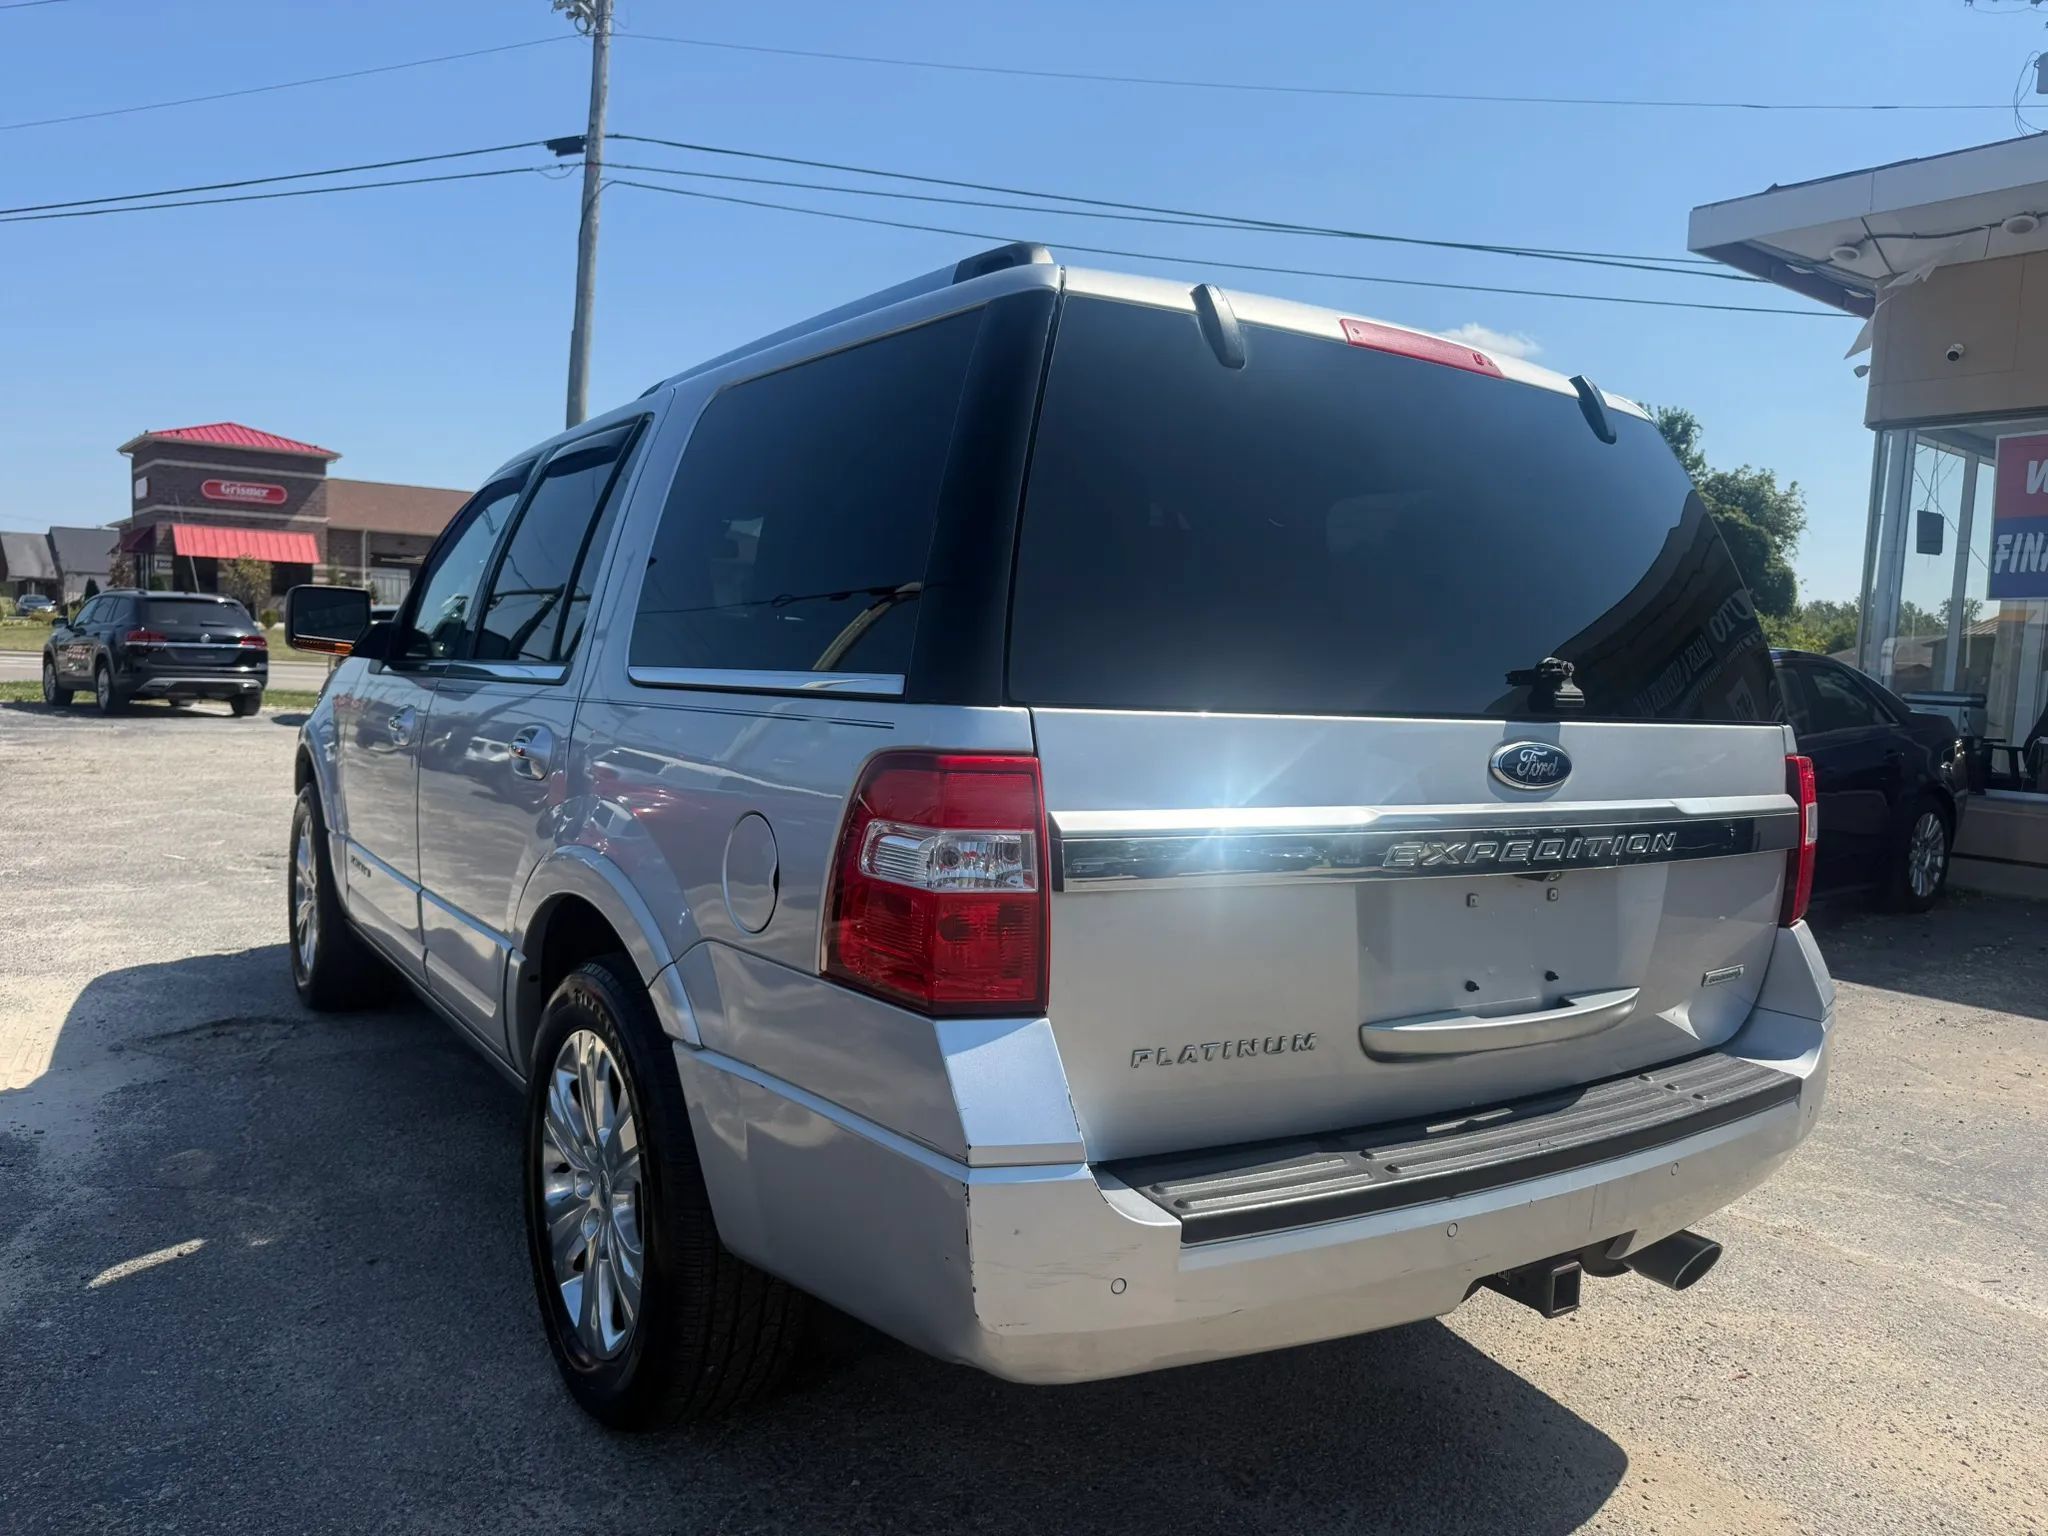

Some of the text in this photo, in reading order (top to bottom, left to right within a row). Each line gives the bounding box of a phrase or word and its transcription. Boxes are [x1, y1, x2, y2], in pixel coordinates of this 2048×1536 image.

[1994, 532, 2048, 574] FIN
[1516, 749, 1559, 776] Ford
[1383, 832, 1677, 867] EXPEDITION
[1131, 1033, 1317, 1068] PLATINUM
